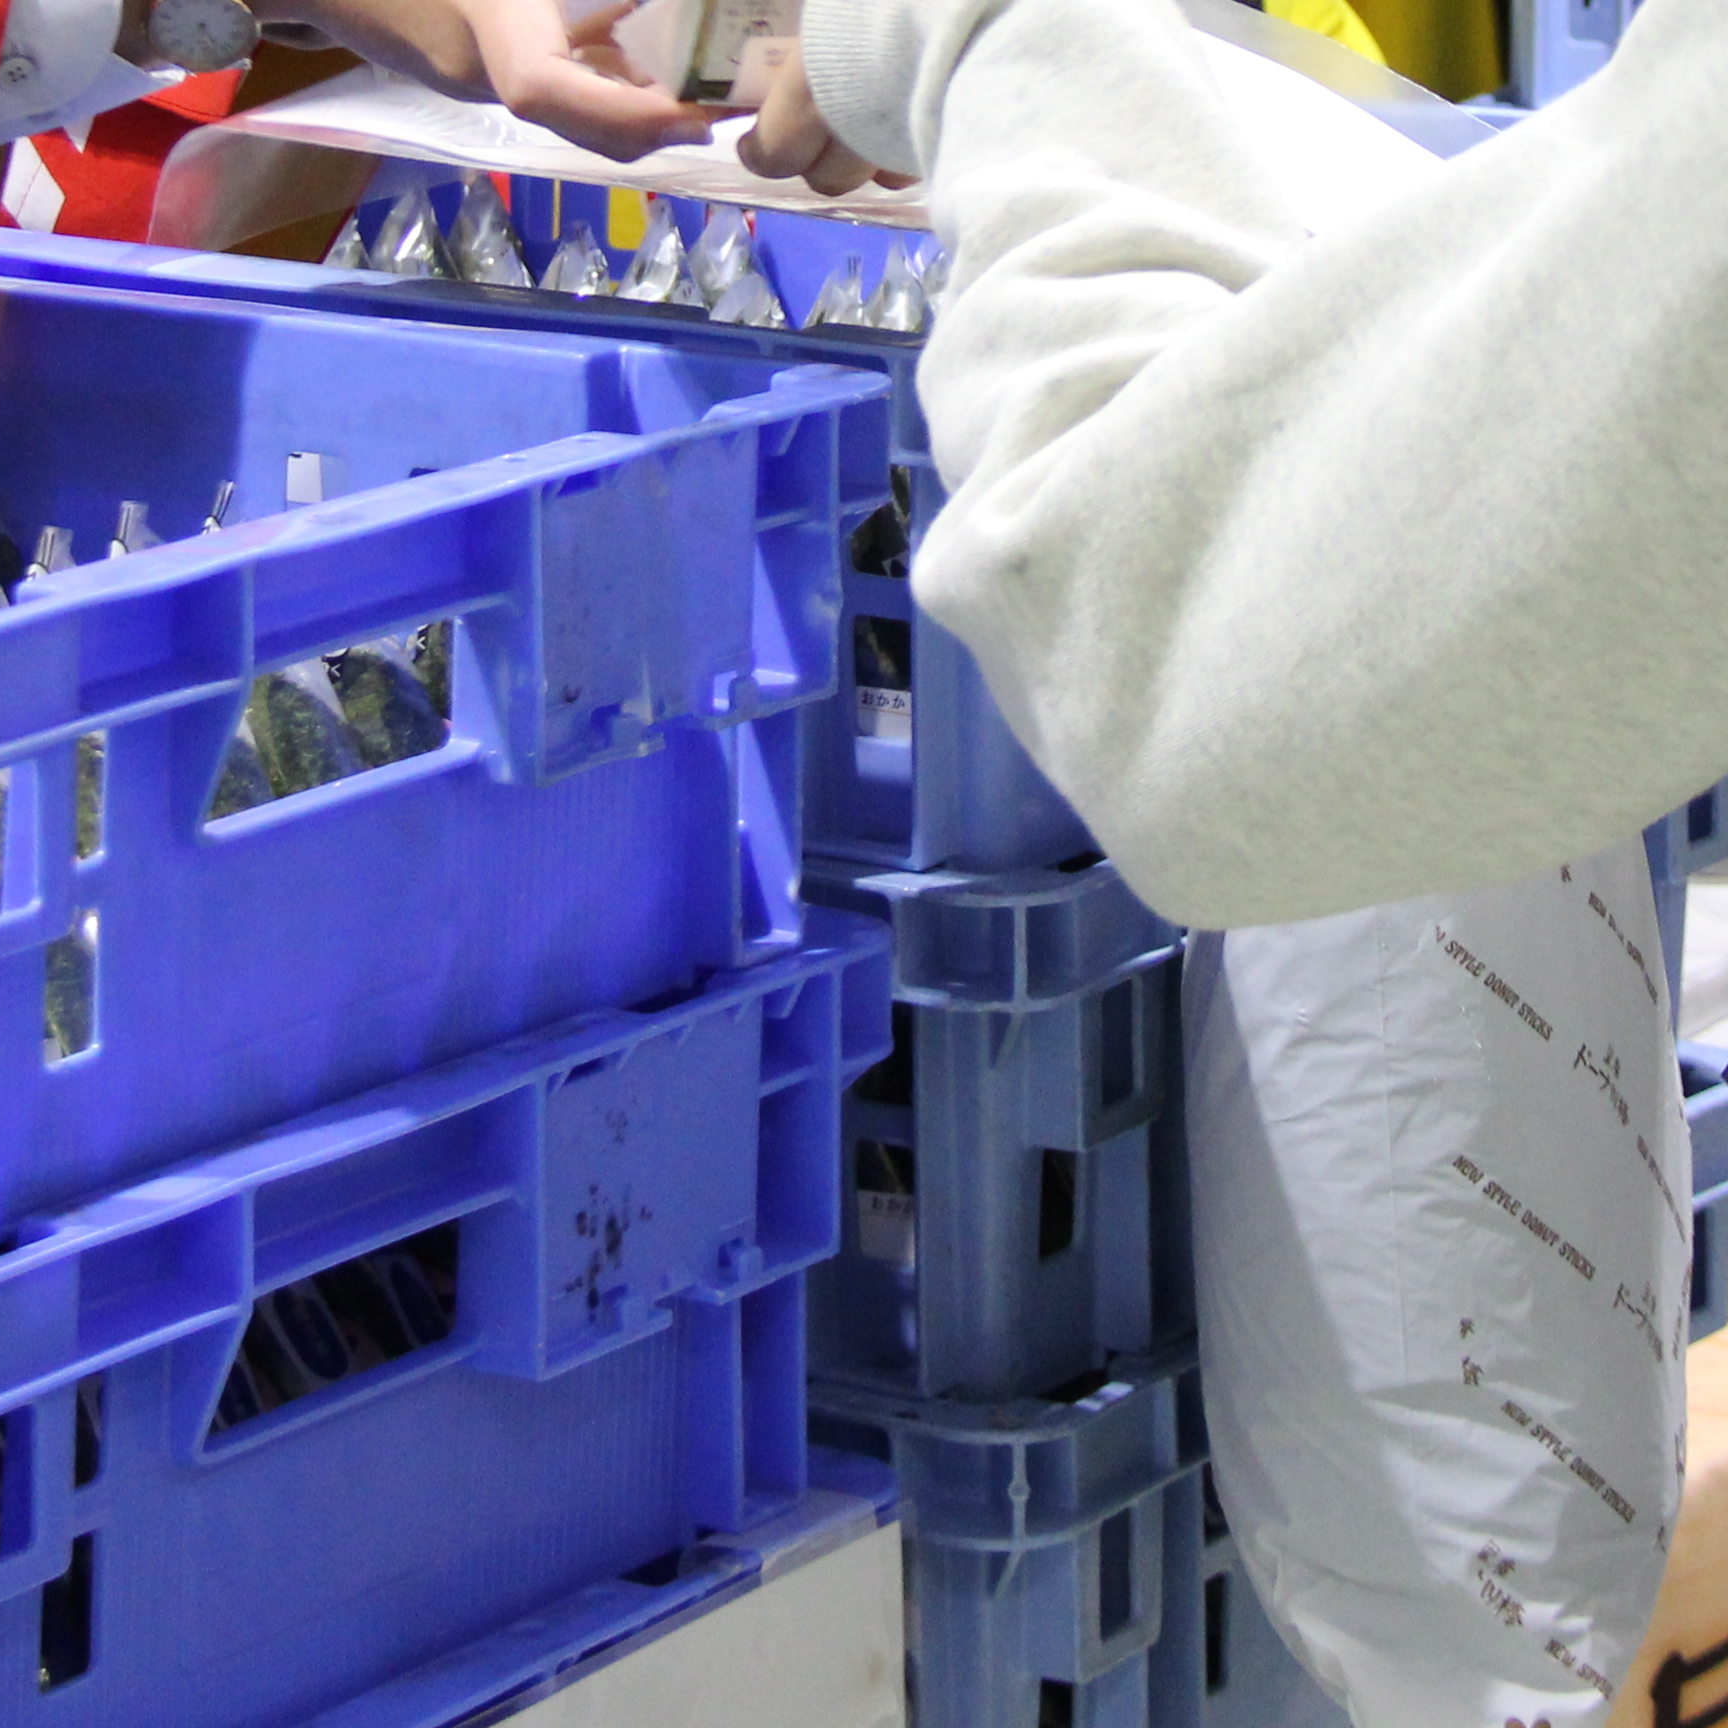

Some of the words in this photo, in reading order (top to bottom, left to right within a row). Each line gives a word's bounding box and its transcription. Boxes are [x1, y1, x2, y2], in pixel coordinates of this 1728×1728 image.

[1444, 940, 1485, 977] STYLE
[1483, 971, 1520, 1009] DONUT
[1517, 1003, 1553, 1041] STICKS
[1452, 1155, 1484, 1184] NEW
[1483, 1181, 1521, 1216] STYLE
[1521, 1209, 1560, 1248] DONUT
[1558, 1241, 1596, 1281] STICKS
[1501, 1399, 1532, 1427] NEW
[1530, 1424, 1571, 1462] STYLE
[1569, 1456, 1605, 1492] DONUT
[1601, 1487, 1636, 1523] STICKS
[1544, 1638, 1576, 1669] NEW
